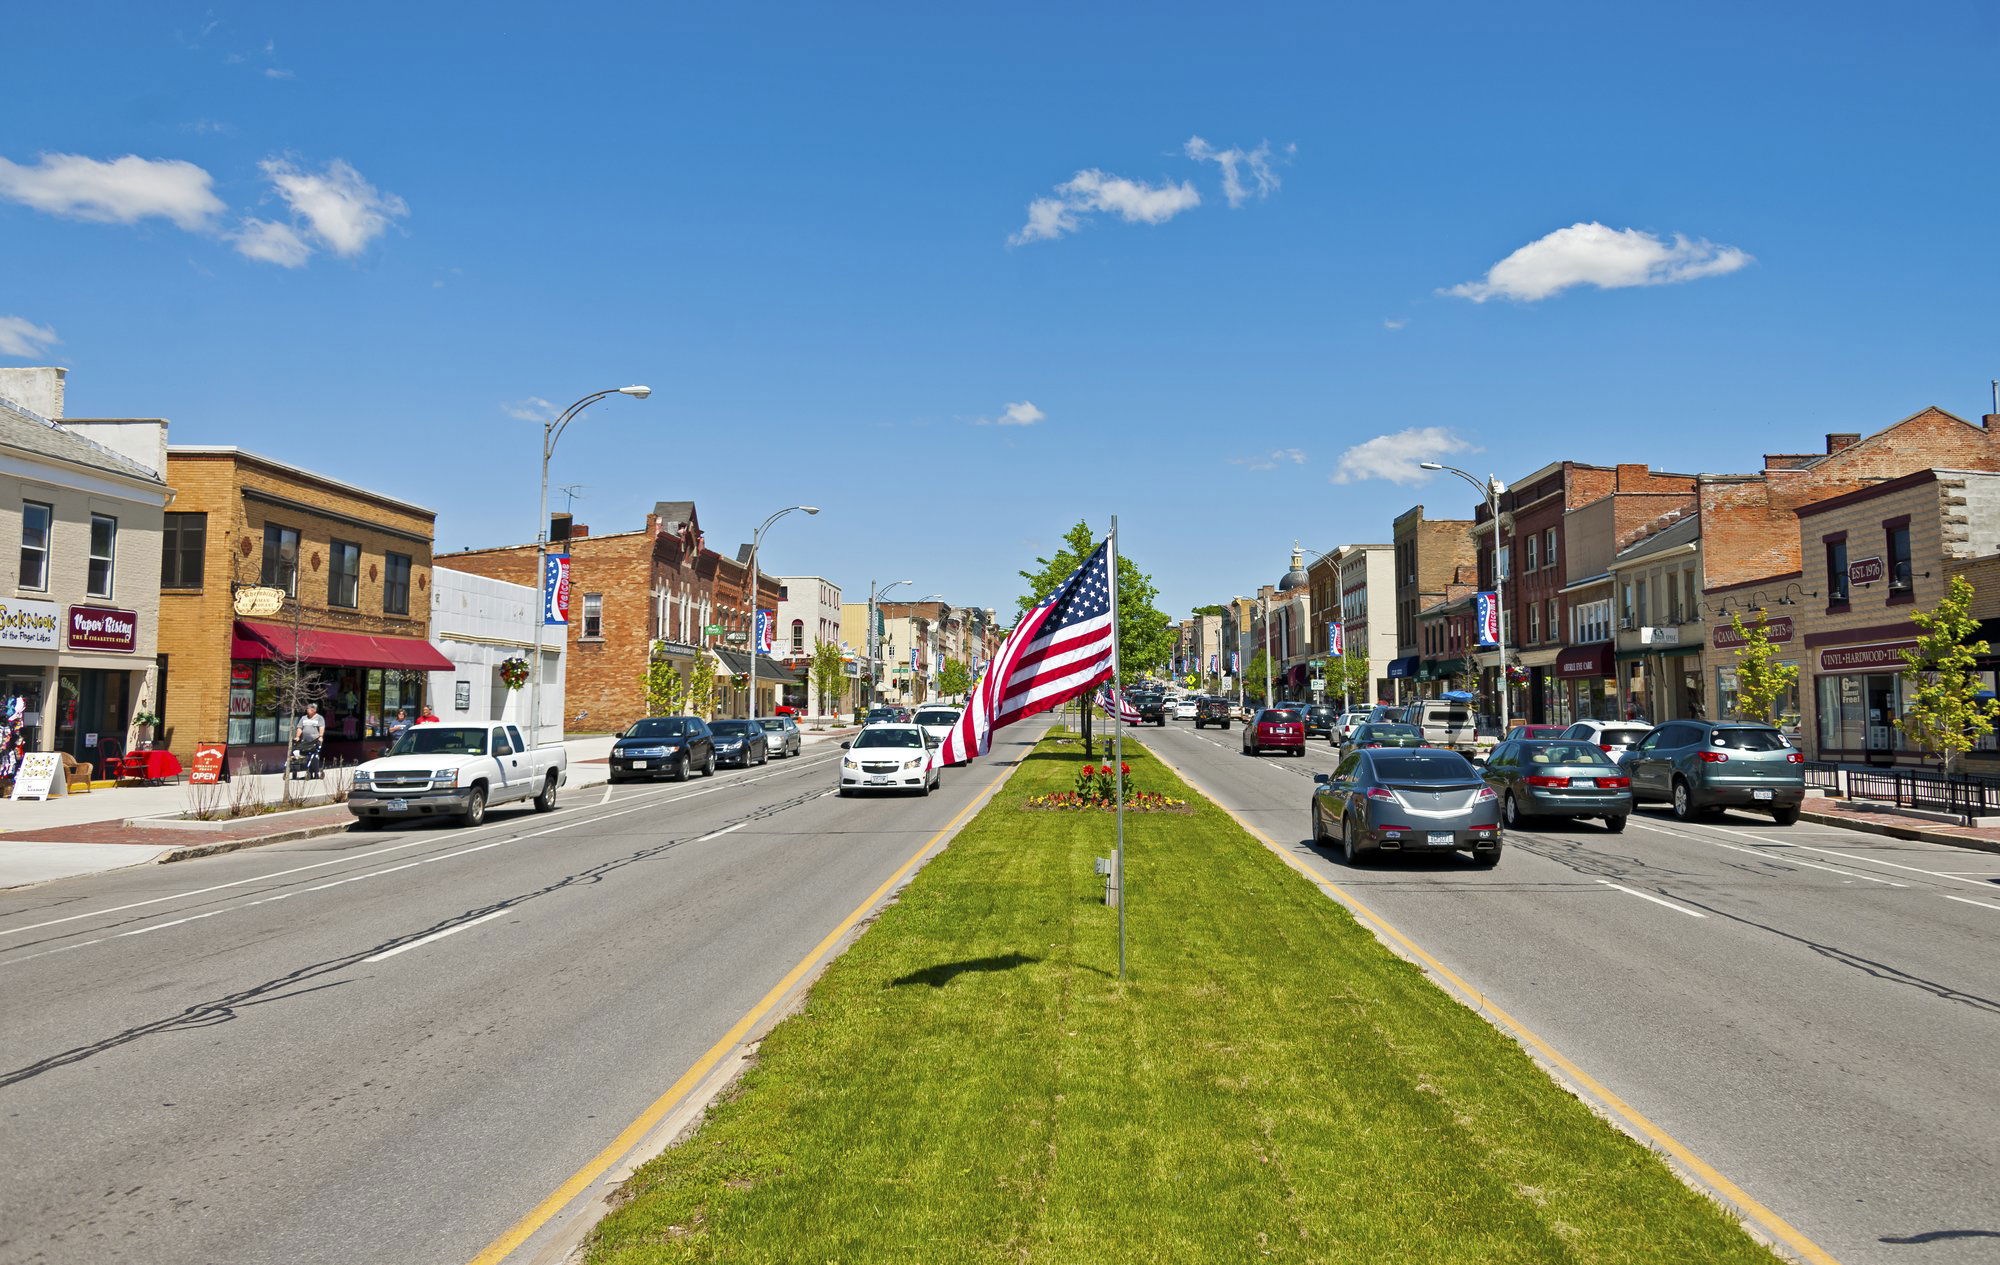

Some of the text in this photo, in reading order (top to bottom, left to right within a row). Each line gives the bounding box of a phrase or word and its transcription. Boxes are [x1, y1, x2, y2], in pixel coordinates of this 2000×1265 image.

[1866, 563, 1879, 577] 1976
[559, 563, 570, 610] Welcome
[74, 613, 133, 642] Vapor Rising
[1823, 654, 1843, 665] VINYL
[1845, 650, 1884, 664] HARDWOOD
[1842, 677, 1849, 691] 6
[1842, 696, 1860, 704] Free!
[192, 772, 216, 780] OPEN
